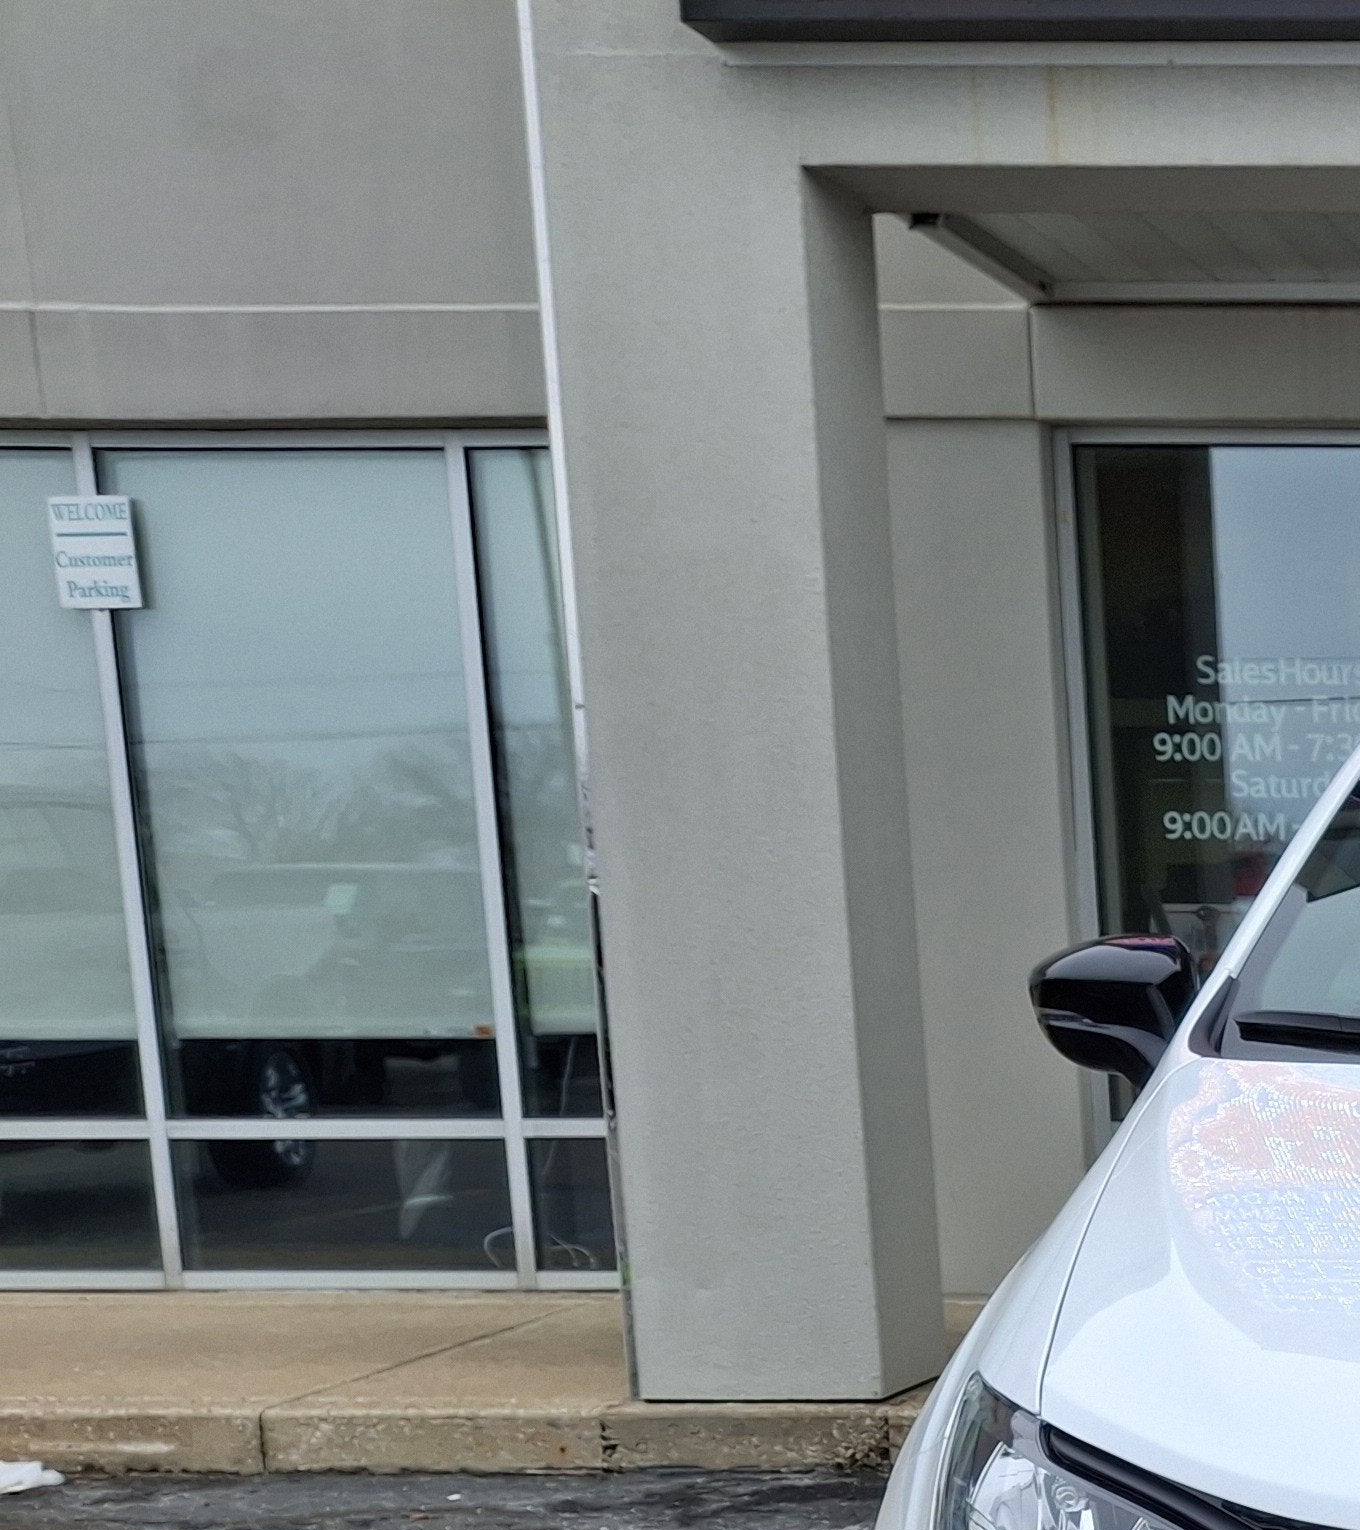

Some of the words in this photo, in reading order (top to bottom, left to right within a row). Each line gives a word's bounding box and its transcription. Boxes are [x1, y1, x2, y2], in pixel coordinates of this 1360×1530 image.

[51, 503, 128, 521] WELCOME
[56, 551, 134, 568] Customer
[66, 580, 130, 602] Parking
[1166, 694, 1286, 732] Monday
[1153, 732, 1222, 761] 9:00
[1231, 733, 1283, 762] AM
[1231, 770, 1331, 799] Saturd
